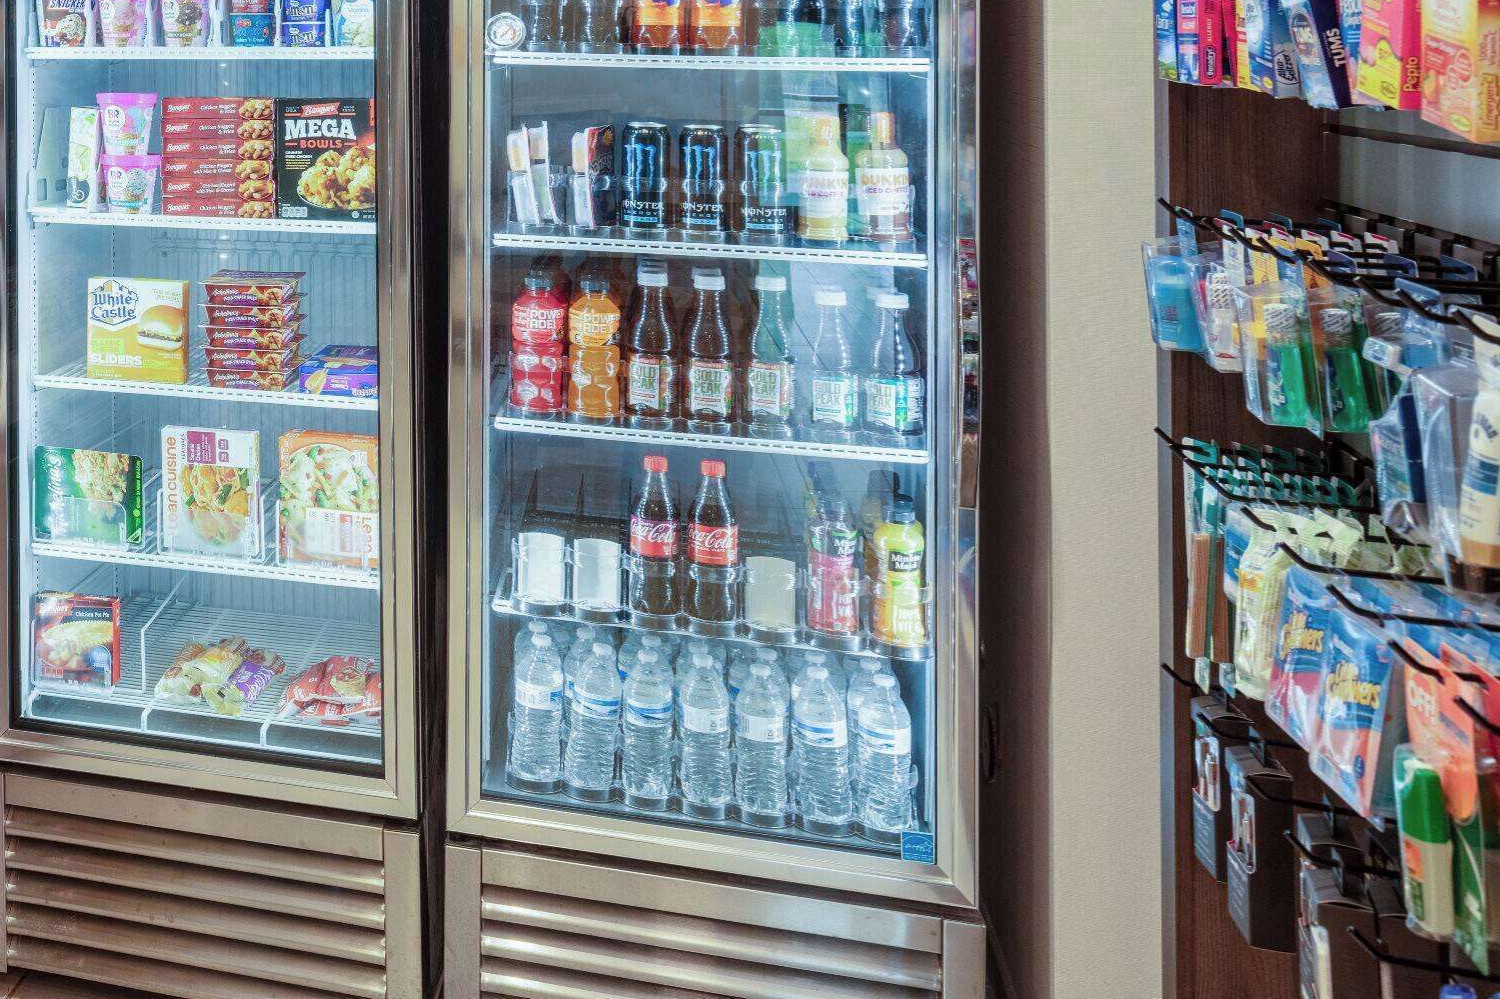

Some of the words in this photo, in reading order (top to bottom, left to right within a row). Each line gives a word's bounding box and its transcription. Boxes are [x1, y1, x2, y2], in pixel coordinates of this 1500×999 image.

[1325, 28, 1346, 68] TUMS
[1276, 57, 1286, 80] Alka-
[1285, 53, 1297, 82] Seltzer
[1402, 56, 1419, 94] Pepto
[166, 104, 191, 113] Banquet
[165, 124, 190, 133] Banquet
[284, 118, 357, 141] MEGA
[166, 143, 190, 153] Banquet
[299, 139, 343, 149] BOWLS
[166, 203, 191, 212] Banquet
[92, 292, 133, 307] White
[90, 305, 136, 319] Castle
[529, 320, 555, 330] ADE
[91, 353, 142, 368] SLIDERS
[693, 382, 721, 395] PEAK
[814, 382, 841, 395] GOLD
[814, 394, 841, 406] PEAK
[894, 561, 918, 570] Maid
[75, 610, 93, 619] Chicken
